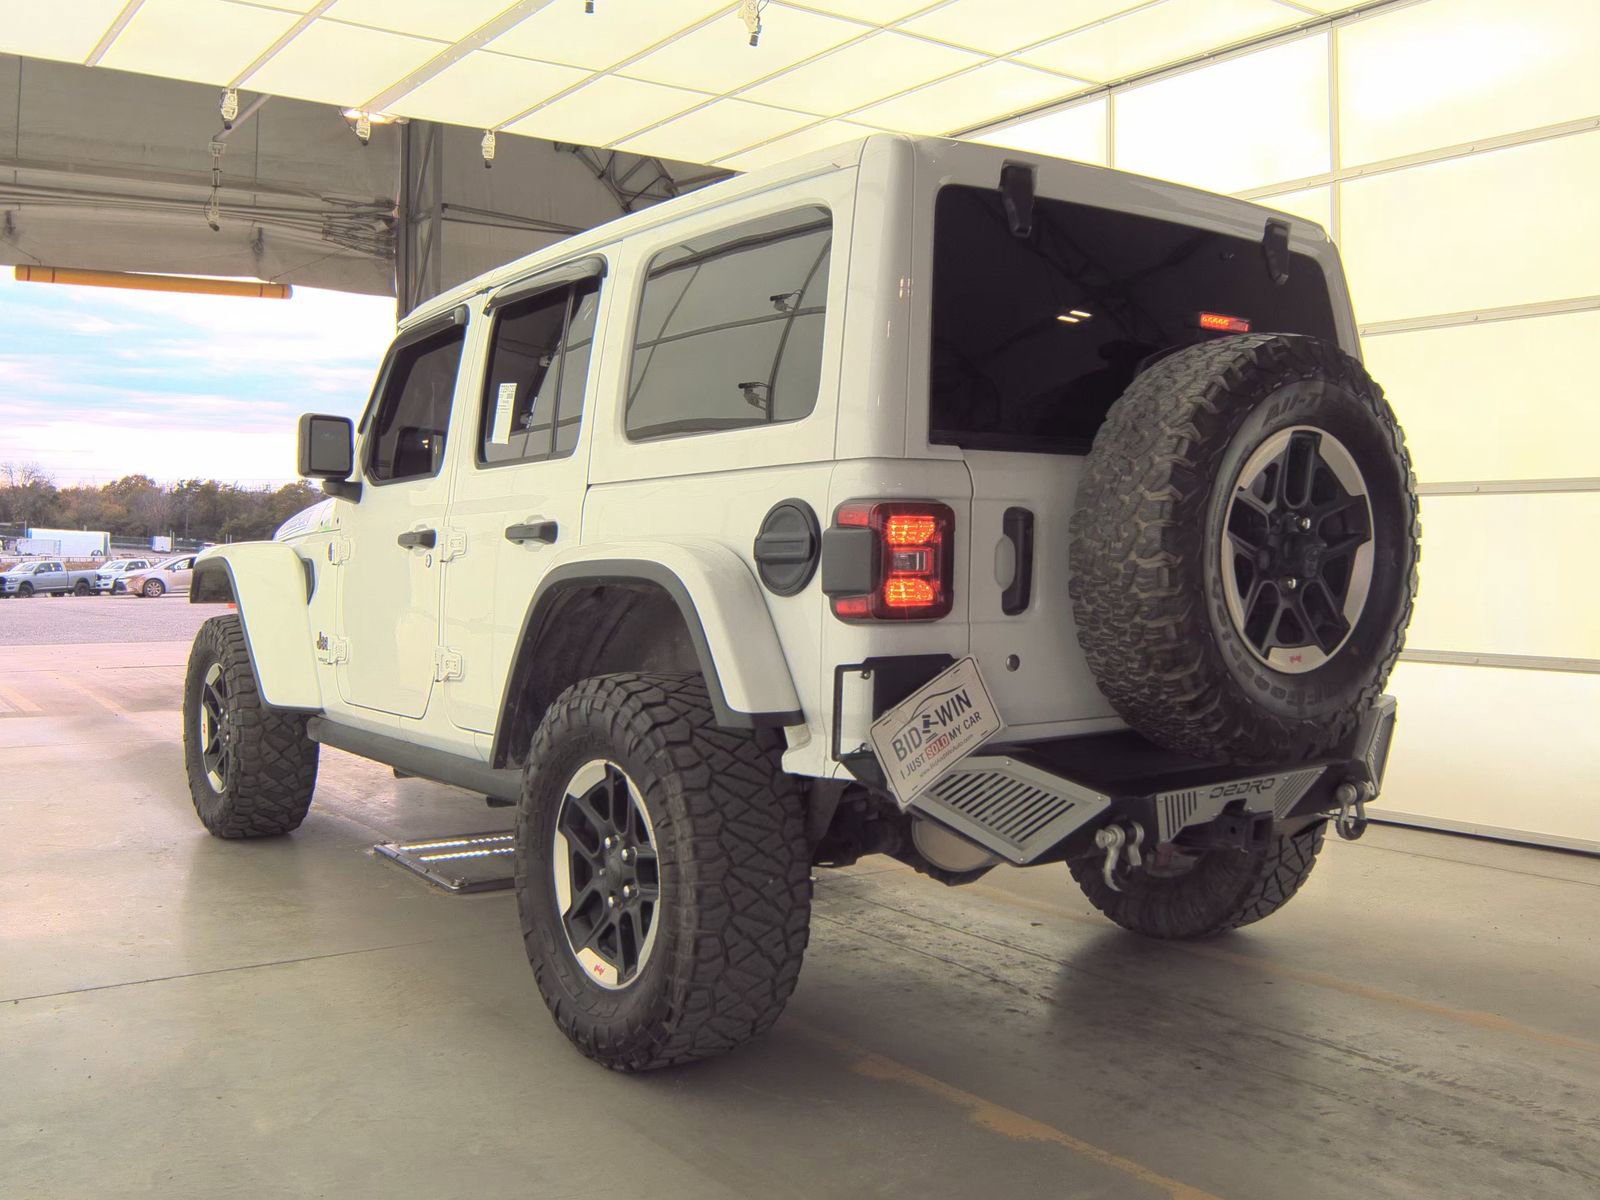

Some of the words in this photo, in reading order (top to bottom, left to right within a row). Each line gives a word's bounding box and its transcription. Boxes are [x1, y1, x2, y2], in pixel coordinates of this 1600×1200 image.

[892, 726, 922, 762] BID
[935, 689, 972, 727] WIN
[900, 769, 906, 780] I
[906, 756, 926, 777] JUST
[926, 735, 949, 760] SOLD
[948, 724, 963, 741] MY
[963, 711, 982, 730] CAR
